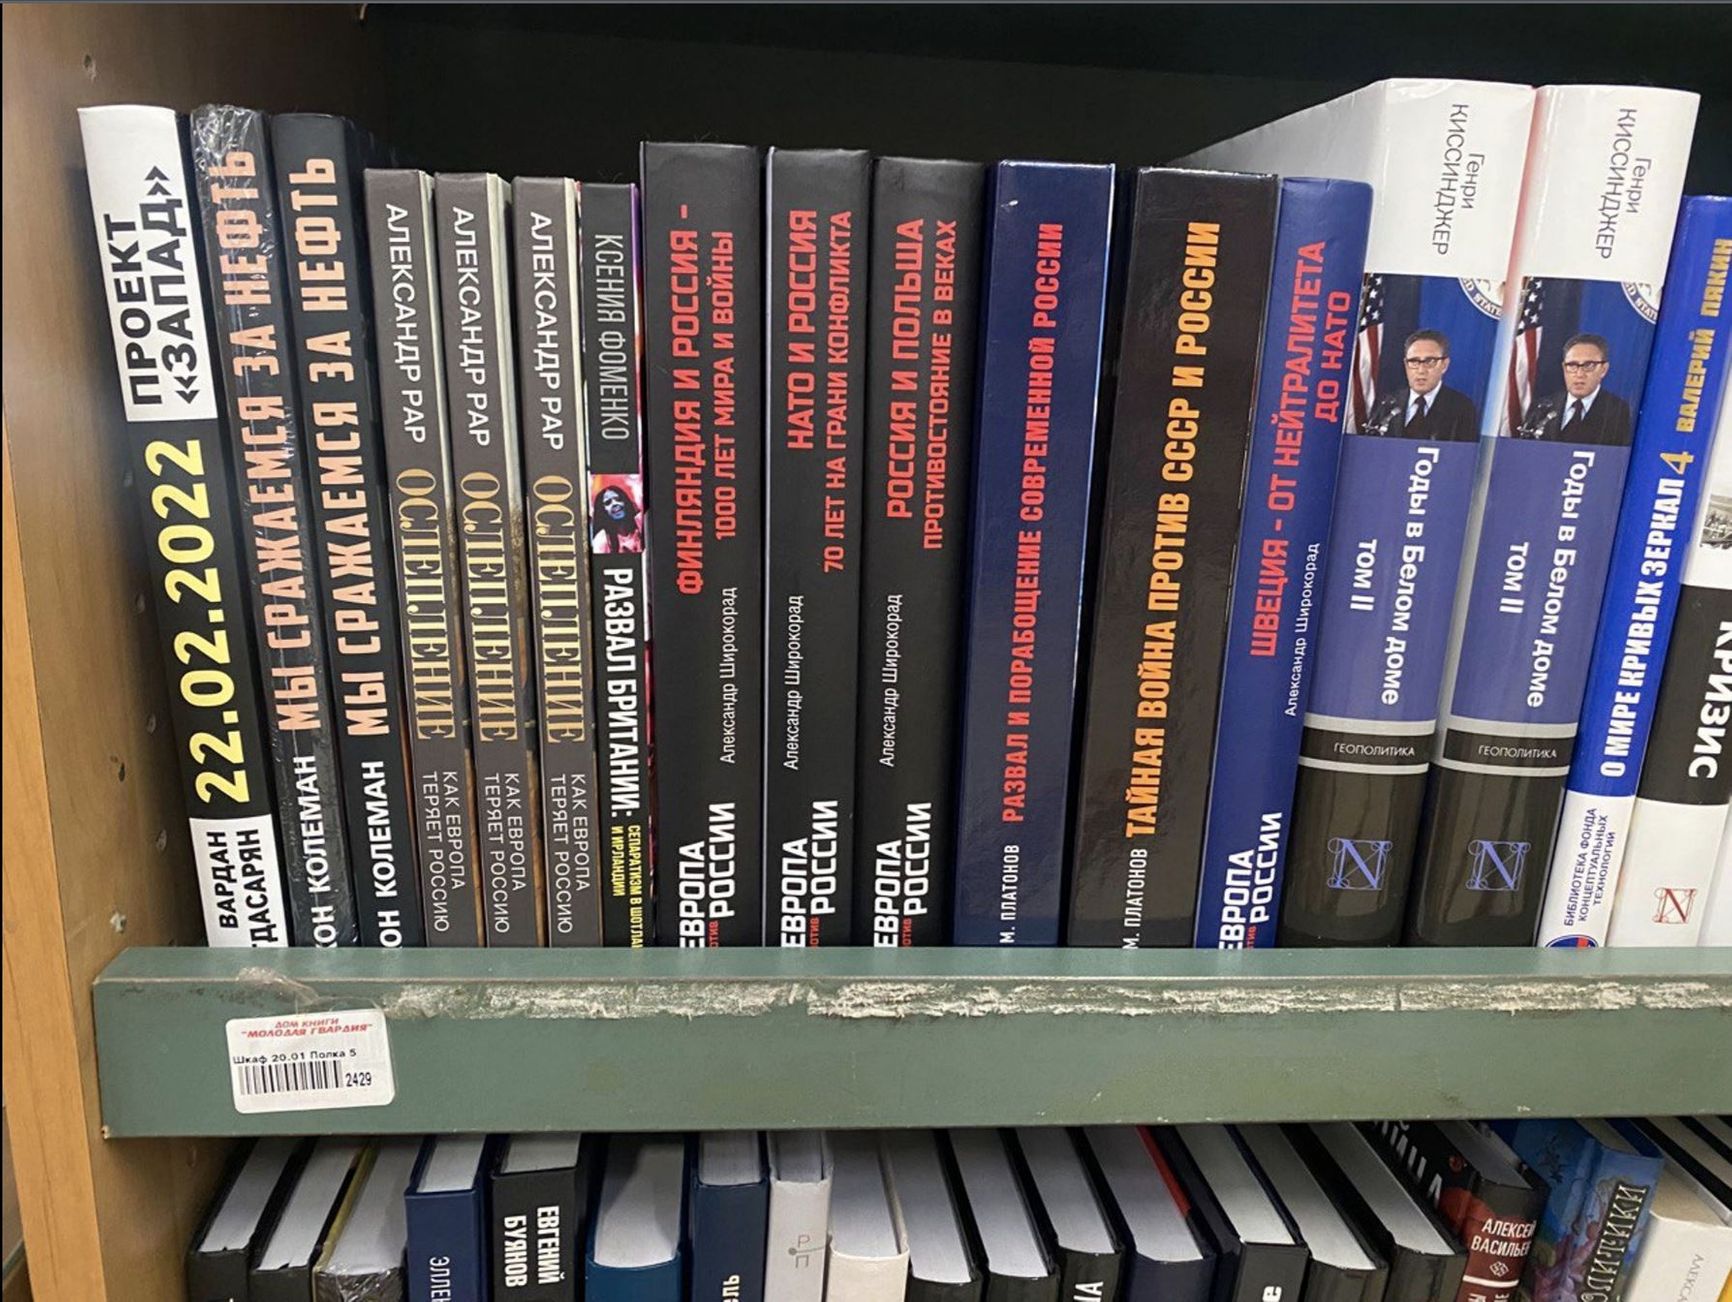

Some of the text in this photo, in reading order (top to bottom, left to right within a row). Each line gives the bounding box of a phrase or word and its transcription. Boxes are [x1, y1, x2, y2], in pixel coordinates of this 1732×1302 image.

[1432, 103, 1469, 256] КИССИНДЖЕР
[1460, 153, 1485, 209] Генри
[1595, 108, 1638, 260] КИССИНДЖЕР
[1625, 157, 1652, 214] Генри
[103, 213, 163, 405] ПРОЕКТ
[139, 165, 200, 404] «ЗАПАД»
[385, 203, 426, 443] АЛЕКСАНДР РАР
[452, 206, 490, 447] АЛЕКСАНДР РАР
[530, 211, 565, 450] АЛЕКСАНДР РАР
[594, 234, 630, 440] КСЕНИЯ ФОМЕНКО
[787, 210, 817, 449] НАТО И РОССИЯ
[1314, 291, 1352, 423] ДО НАТО
[1676, 237, 1732, 432] ВАЛЕРИЙ ПЯКИН
[208, 150, 322, 732] МЫ СРАЖАЕМСЯ ЗА НЕФТЬ
[289, 157, 390, 736] МЫ СРАЖАЕМСЯ ЗА НЕФТЬ
[670, 230, 705, 595] ФИНЛЯНДИЯ И РОССИЯ
[706, 232, 736, 540] 1000 ЛЕТ МИРА И ВОЙНЫ
[823, 210, 852, 573] 70 ЛЕТ НА ГРАНИ КОНФЛИКТА
[887, 218, 924, 518] РОССИЯ И ПОЛЬША
[923, 220, 957, 549] ПРОТИВОСТОЯНИЕ В ВЕКАХ
[1003, 223, 1064, 822] РАЗВАЛ И ПОРАБОЩЕНИЕ СОВРЕМЕННОЙ РОССИИ
[1125, 221, 1221, 838] ТАЙНАЯ ВОЙНА ПРОТИВ СССР И РОССИИ
[1250, 241, 1326, 657] ШВЕЦИЯ ОТ НЕЙТРАЛИТЕТА
[144, 439, 250, 804] 22.02.2022
[396, 468, 456, 740] ОСЛЕПЛЕНИЕ
[460, 471, 519, 743] ОСЛЕПЛЕНИЕ
[533, 475, 586, 744] ОСЛЕПЛЕНИЕ
[1284, 543, 1320, 717] Александр Широкорад
[1381, 446, 1440, 705] Годы в Белом доме
[1526, 450, 1596, 708] Годы в Белом доме
[1600, 450, 1695, 778] О МИРЕ КРИВЫХ ЗЕРКАЛ 4
[603, 568, 641, 818] РАЗВАЛ БРИТАНИИ:
[720, 587, 739, 764] Александр Широкорад
[783, 595, 804, 770] Александр Широкорад
[879, 594, 903, 767] Александр Широкорад
[1333, 741, 1415, 757] ГЕОПОЛИТИКА
[1478, 743, 1558, 759] ГЕОПОЛИТИКА
[206, 831, 239, 929] ВАРДАН
[236, 829, 278, 947] ДАСАРЯН
[293, 756, 338, 948] ОН КОЛЕМАН
[361, 761, 402, 948] ОН КОЛЕМАН
[422, 771, 450, 932] ТЕРЯЕТ РОССИЮ
[443, 771, 466, 890] КАК ЕВРОПА
[484, 772, 510, 933] ТЕРЯЕТ РОССИЮ
[504, 773, 527, 891] КАК ЕВРОПА
[550, 774, 573, 934] ТЕРЯЕТ РОССИЮ
[571, 774, 591, 891] КАК ЕВРОПА
[610, 825, 625, 897] И ИРЛАНДИИ
[627, 825, 642, 894] СЕПАРАТИЗМ
[629, 897, 643, 906] В
[708, 802, 736, 918] РОССИИ
[780, 837, 808, 948] ЕВРОПА
[810, 800, 839, 915] РОССИИ
[873, 839, 902, 948] ЕВРОПА
[903, 802, 932, 916] РОССИИ
[999, 844, 1020, 944] М. ПЛАТОНОВ
[1123, 848, 1148, 928] ПЛАТОНОВ
[1249, 811, 1283, 923] РОССИИ
[1564, 807, 1598, 927] БИБЛИОТЕКА ФОНДА
[1578, 815, 1608, 922] КОНЦЕПТУАЛЬНЫХ
[232, 1048, 357, 1065] Шкаф 20.01 Полка 5
[274, 1018, 339, 1029] ДОМ КНИГИ
[345, 1072, 372, 1087] 2429
[504, 1215, 528, 1288] БУЯНОВ
[536, 1205, 565, 1285] ЕВГЕНИЙ
